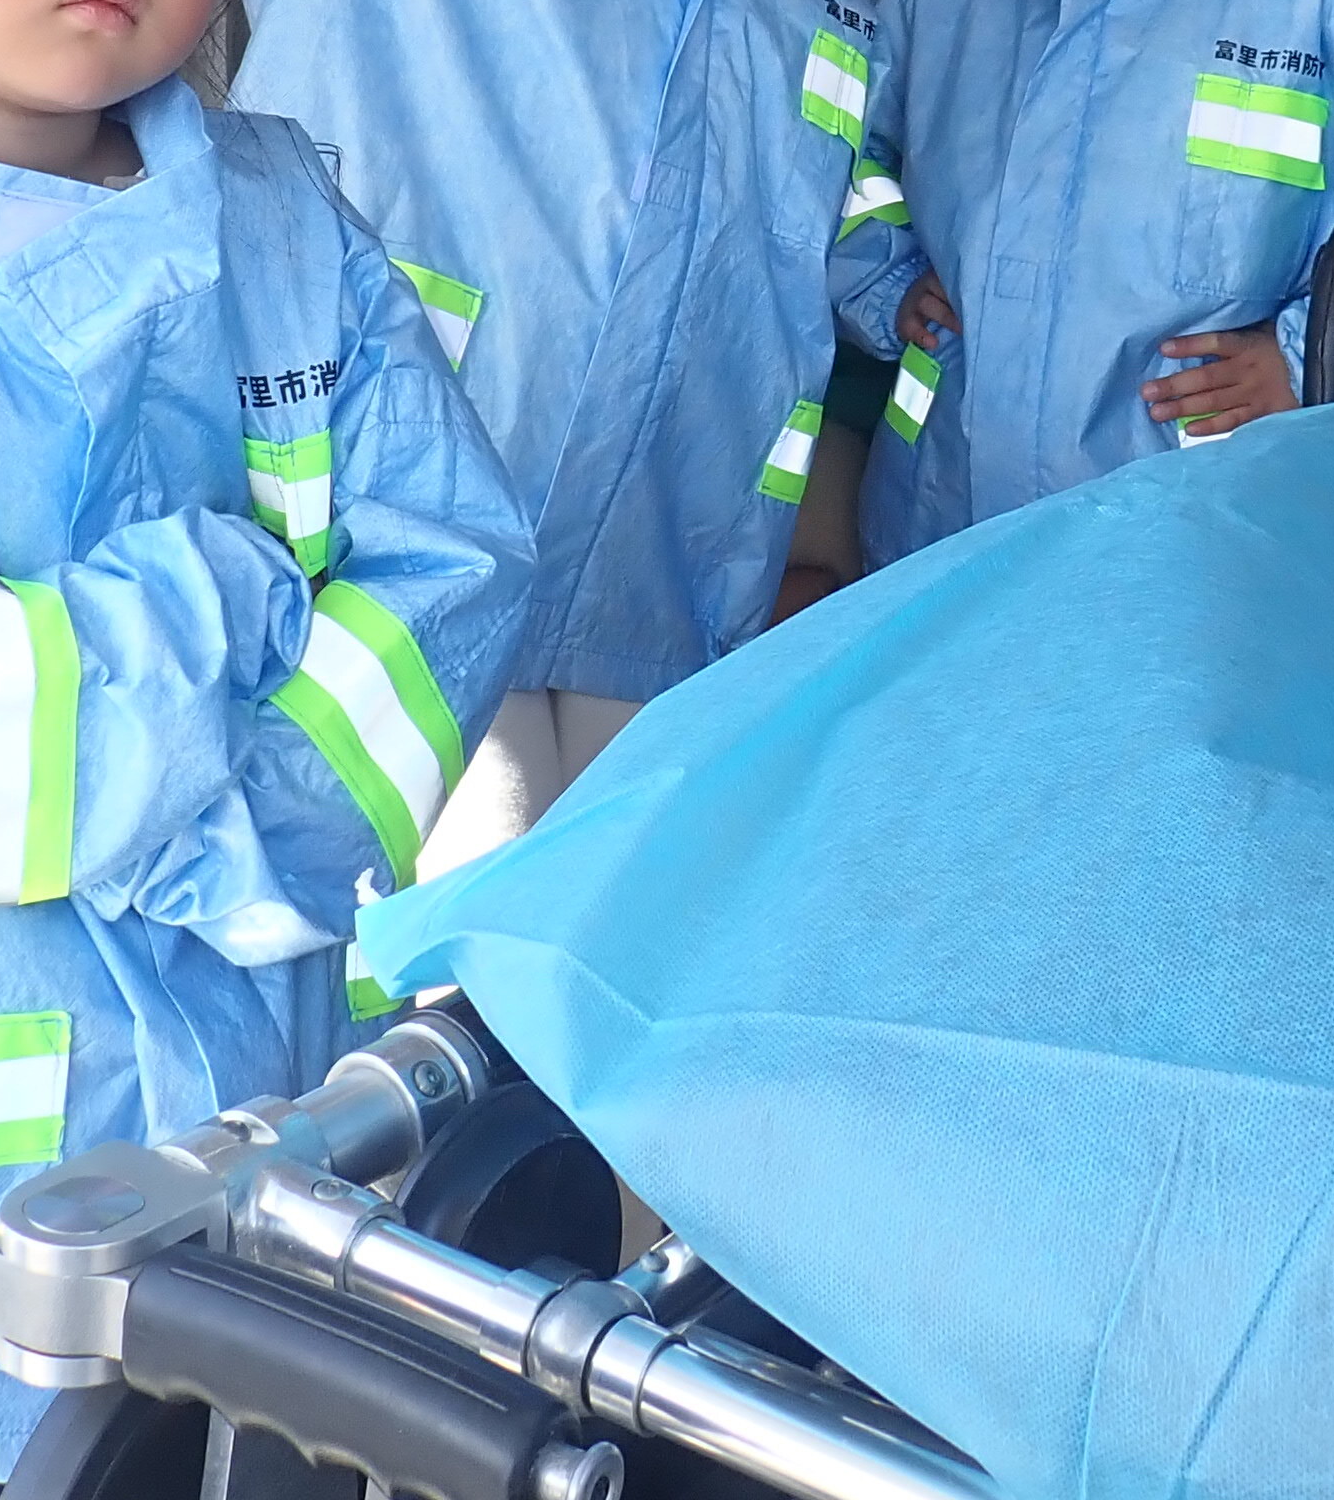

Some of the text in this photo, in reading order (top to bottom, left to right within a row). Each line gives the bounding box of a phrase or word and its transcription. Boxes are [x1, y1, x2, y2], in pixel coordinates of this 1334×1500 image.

[1214, 39, 1326, 81] 富里市消防
